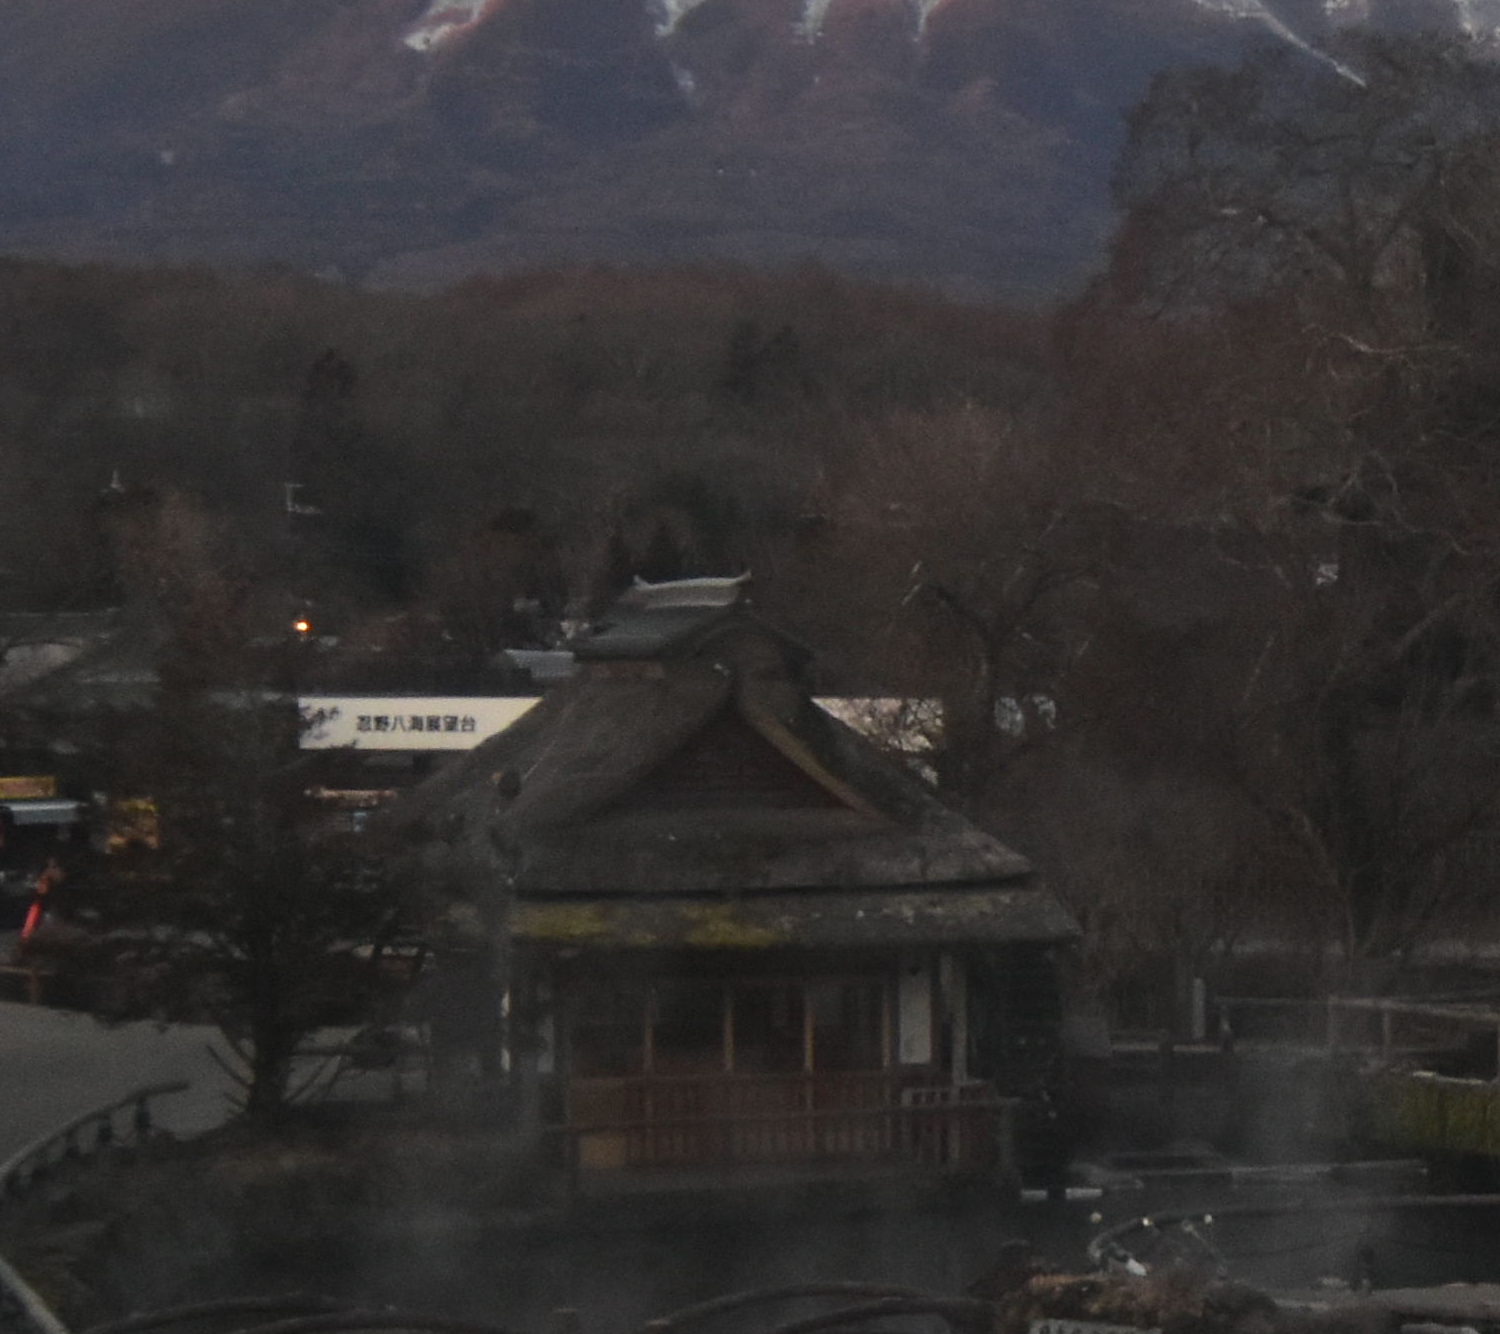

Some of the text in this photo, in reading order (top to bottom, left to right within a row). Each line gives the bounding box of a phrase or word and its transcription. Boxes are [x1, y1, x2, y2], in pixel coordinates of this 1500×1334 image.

[357, 715, 476, 732] 忍野八海展望台
